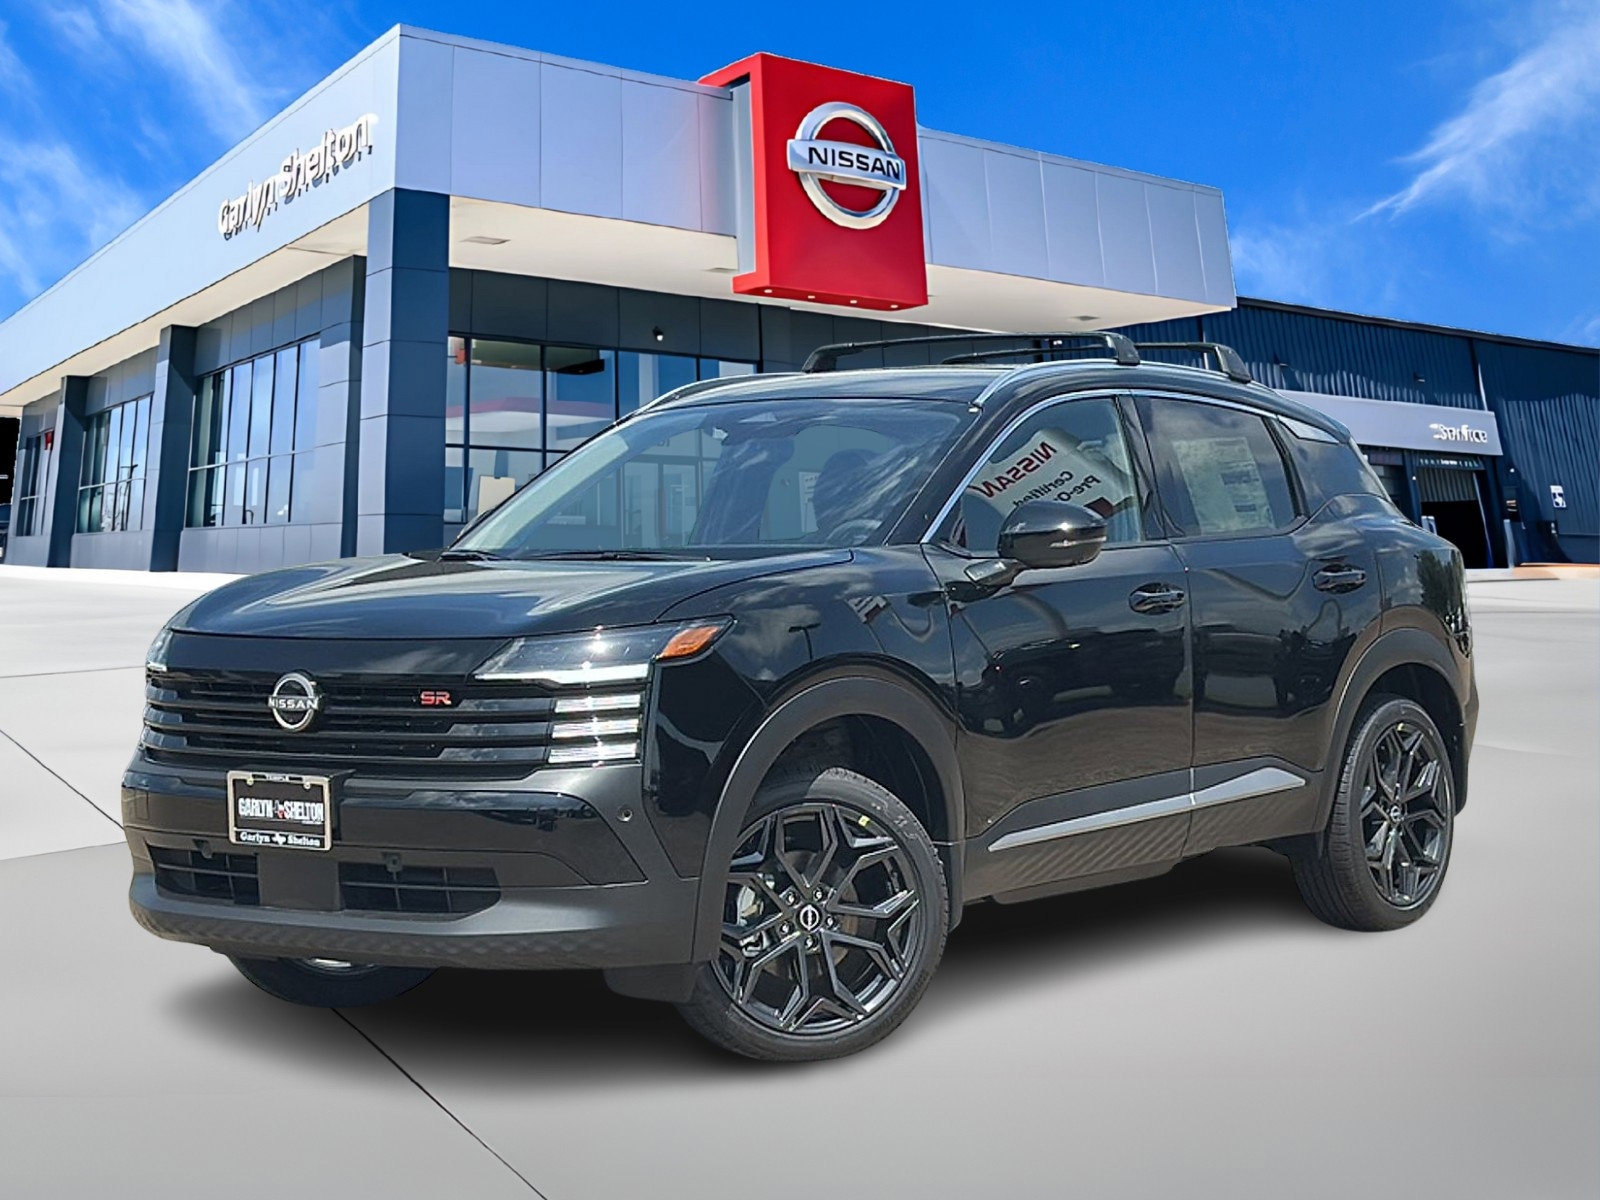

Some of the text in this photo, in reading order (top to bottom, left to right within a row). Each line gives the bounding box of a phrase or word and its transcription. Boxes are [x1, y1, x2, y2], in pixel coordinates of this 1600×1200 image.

[278, 117, 375, 202] Shelton
[808, 146, 900, 181] NISSAN
[268, 696, 318, 710] NISSAN
[420, 691, 452, 705] SR
[284, 800, 324, 821] SHELTON
